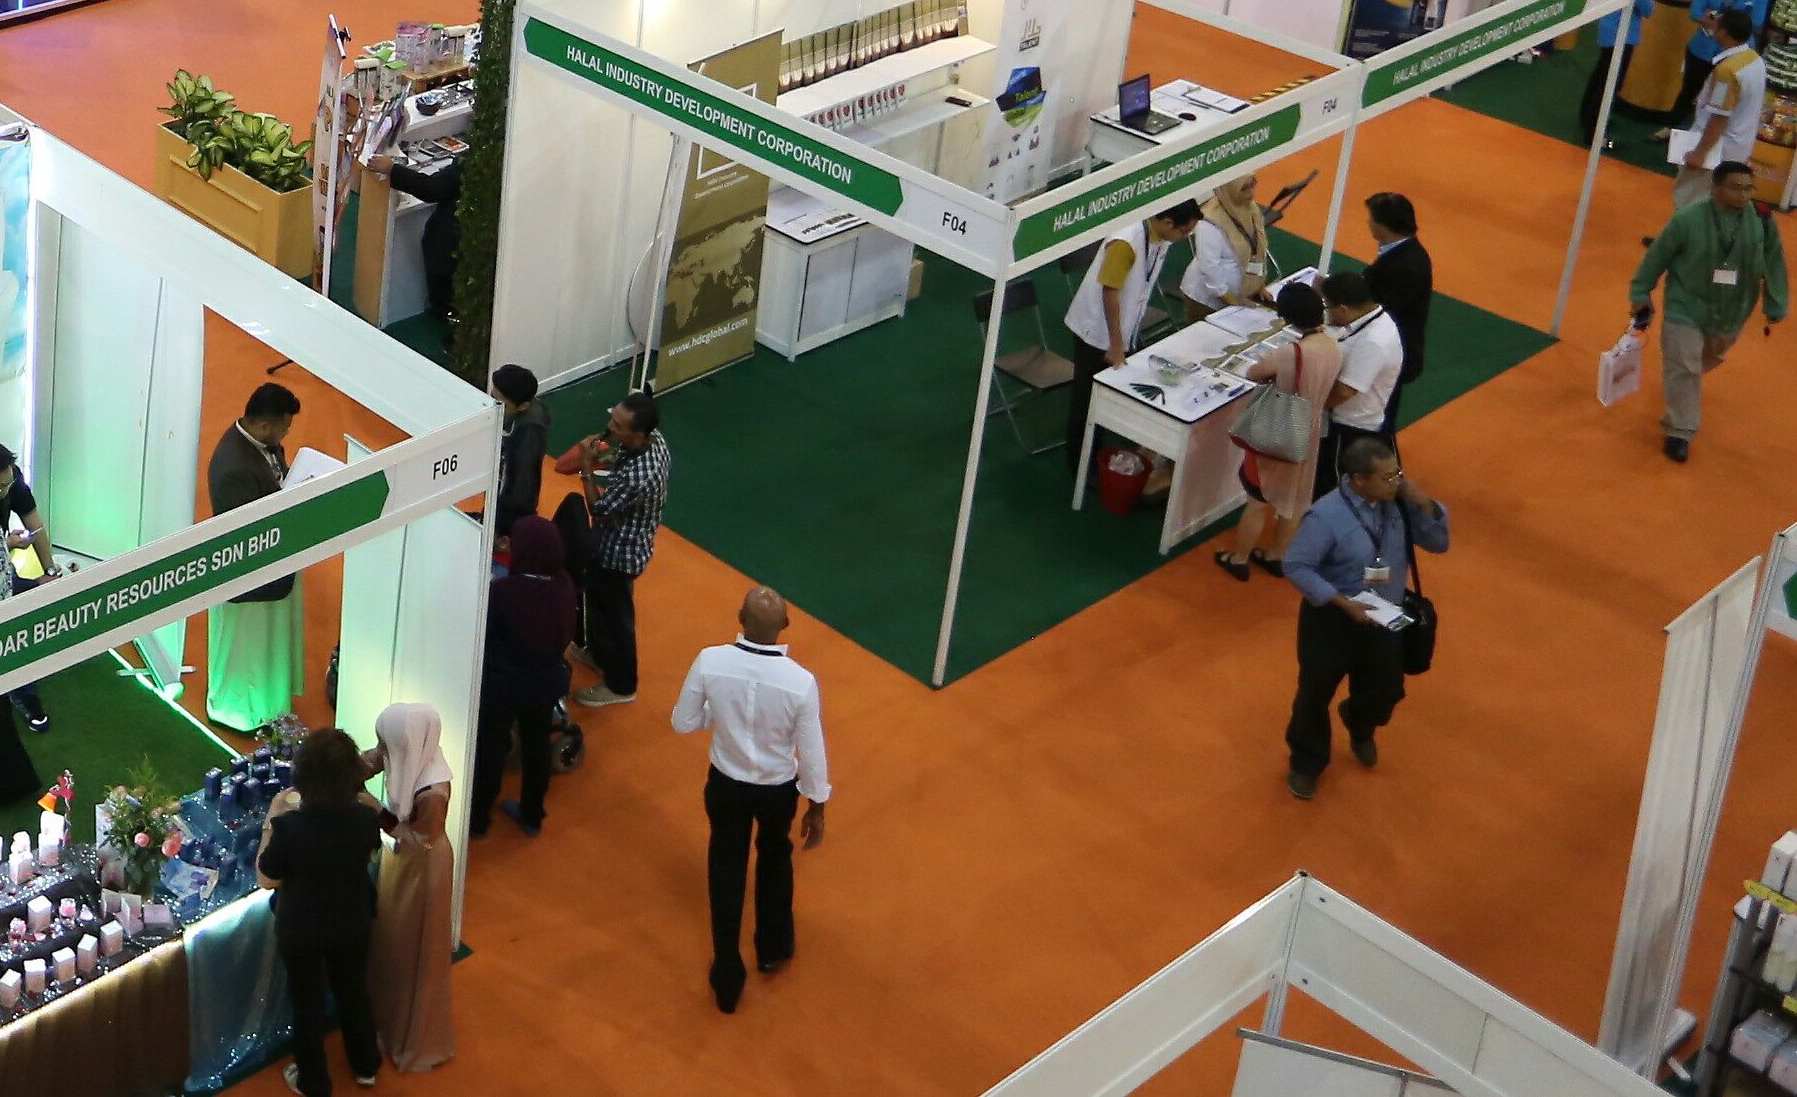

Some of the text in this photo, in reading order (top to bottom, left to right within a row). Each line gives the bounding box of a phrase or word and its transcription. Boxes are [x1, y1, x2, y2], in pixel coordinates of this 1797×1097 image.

[566, 44, 852, 185] HALAL INDUSTRY DEVELOPMENT CORPORATION
[941, 211, 967, 236] F04
[1053, 126, 1271, 234] HALAL INDUSTRY DEVELOPMENT CORPORATION
[431, 453, 459, 482] F06
[32, 601, 103, 645] BEAUTY
[105, 556, 208, 618] RESOURCES
[211, 543, 243, 577] SDN
[245, 527, 282, 564] BHD
